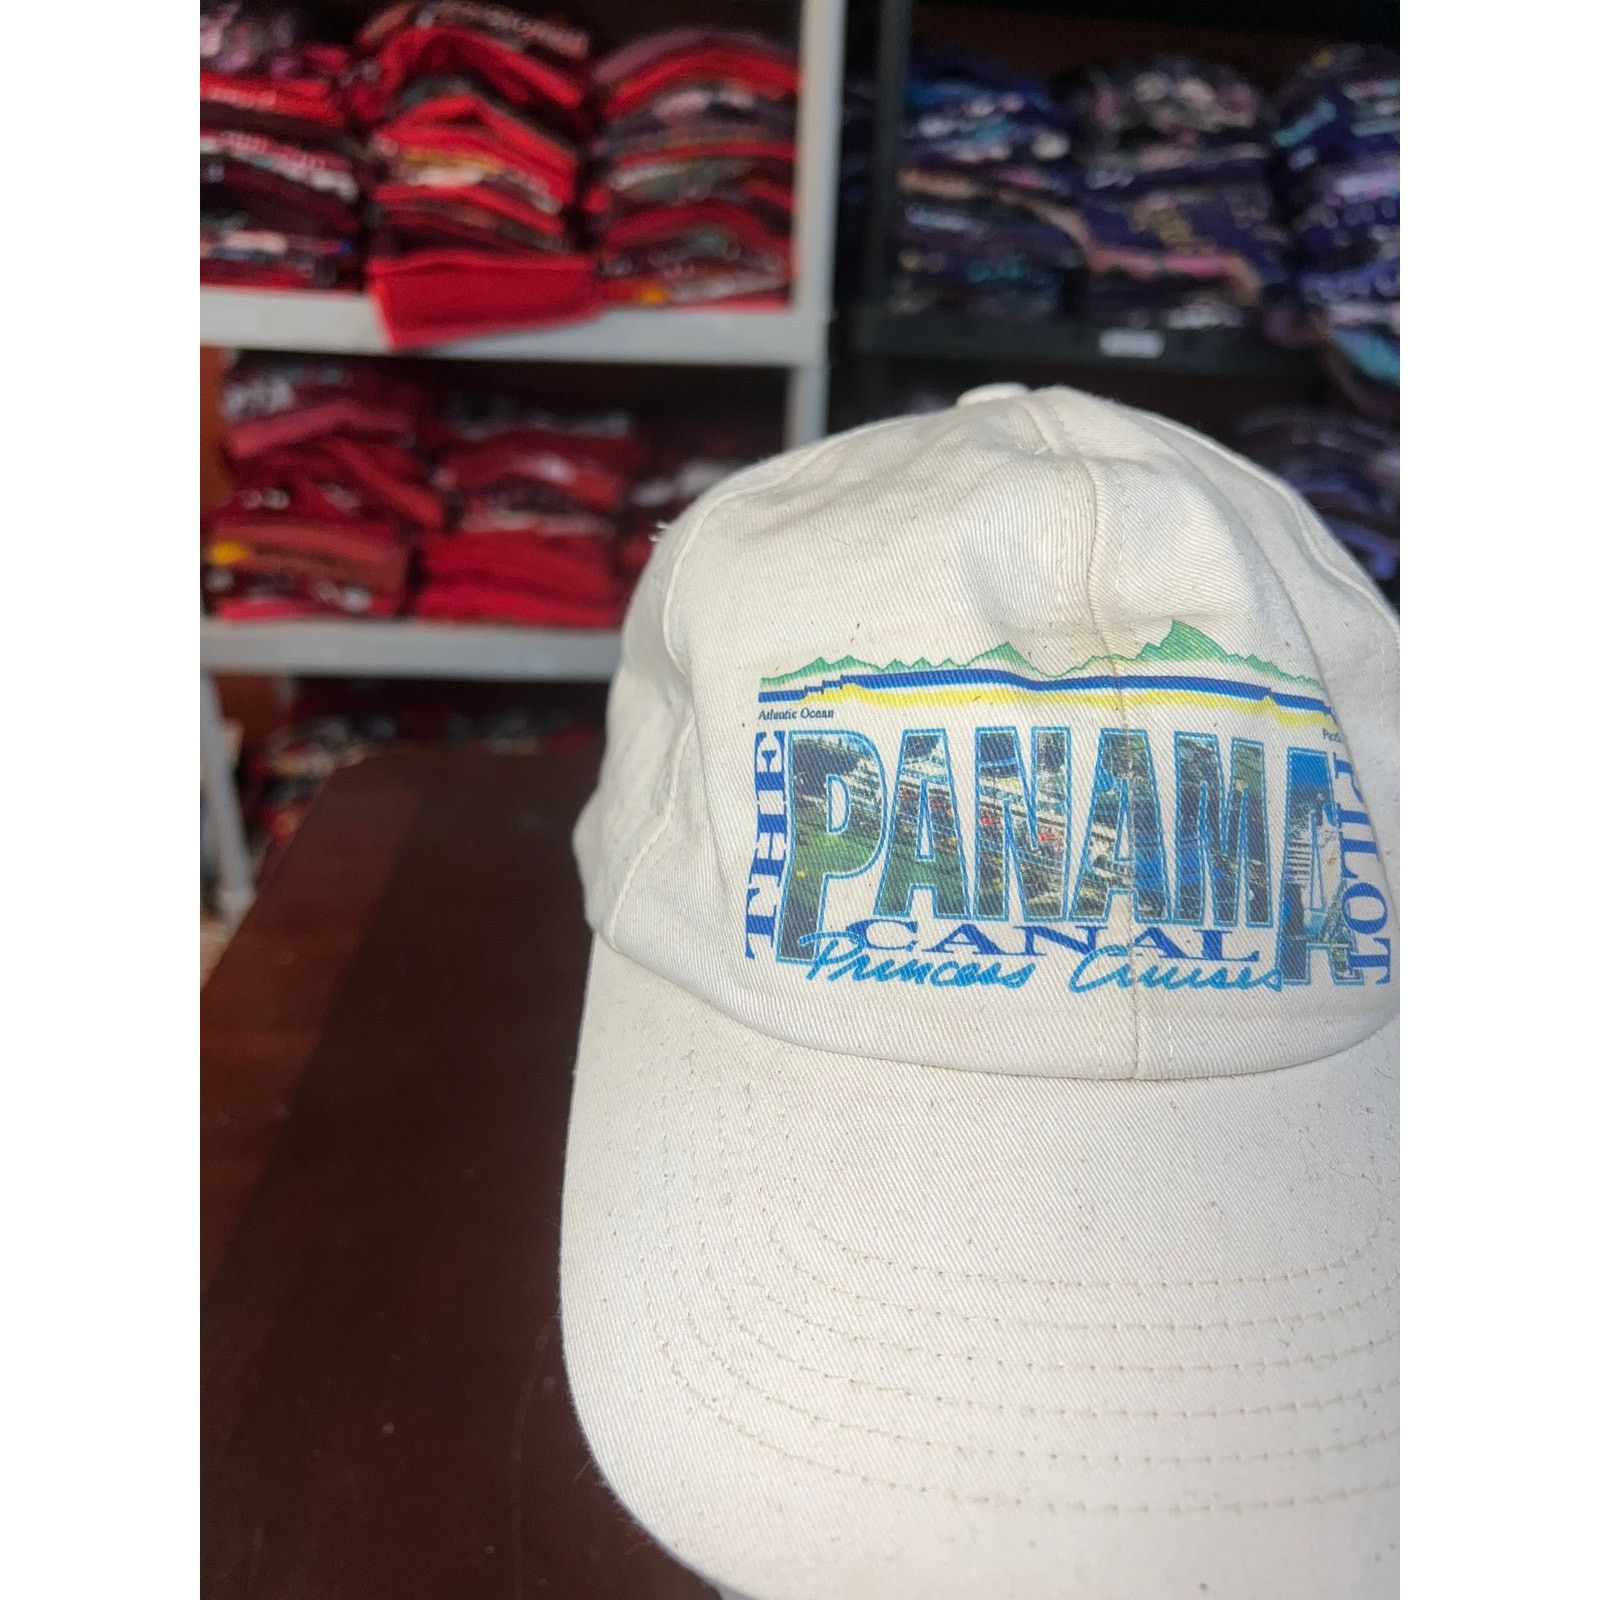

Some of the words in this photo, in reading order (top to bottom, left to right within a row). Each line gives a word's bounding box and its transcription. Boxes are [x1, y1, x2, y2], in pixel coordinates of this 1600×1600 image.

[758, 707, 798, 721] Atlantic
[800, 707, 834, 719] Ocean
[745, 730, 787, 961] THE
[776, 725, 1365, 986] PANAMA
[799, 930, 1037, 989] Princess
[1068, 944, 1283, 993] Cruises
[845, 918, 1260, 962] CANAL
